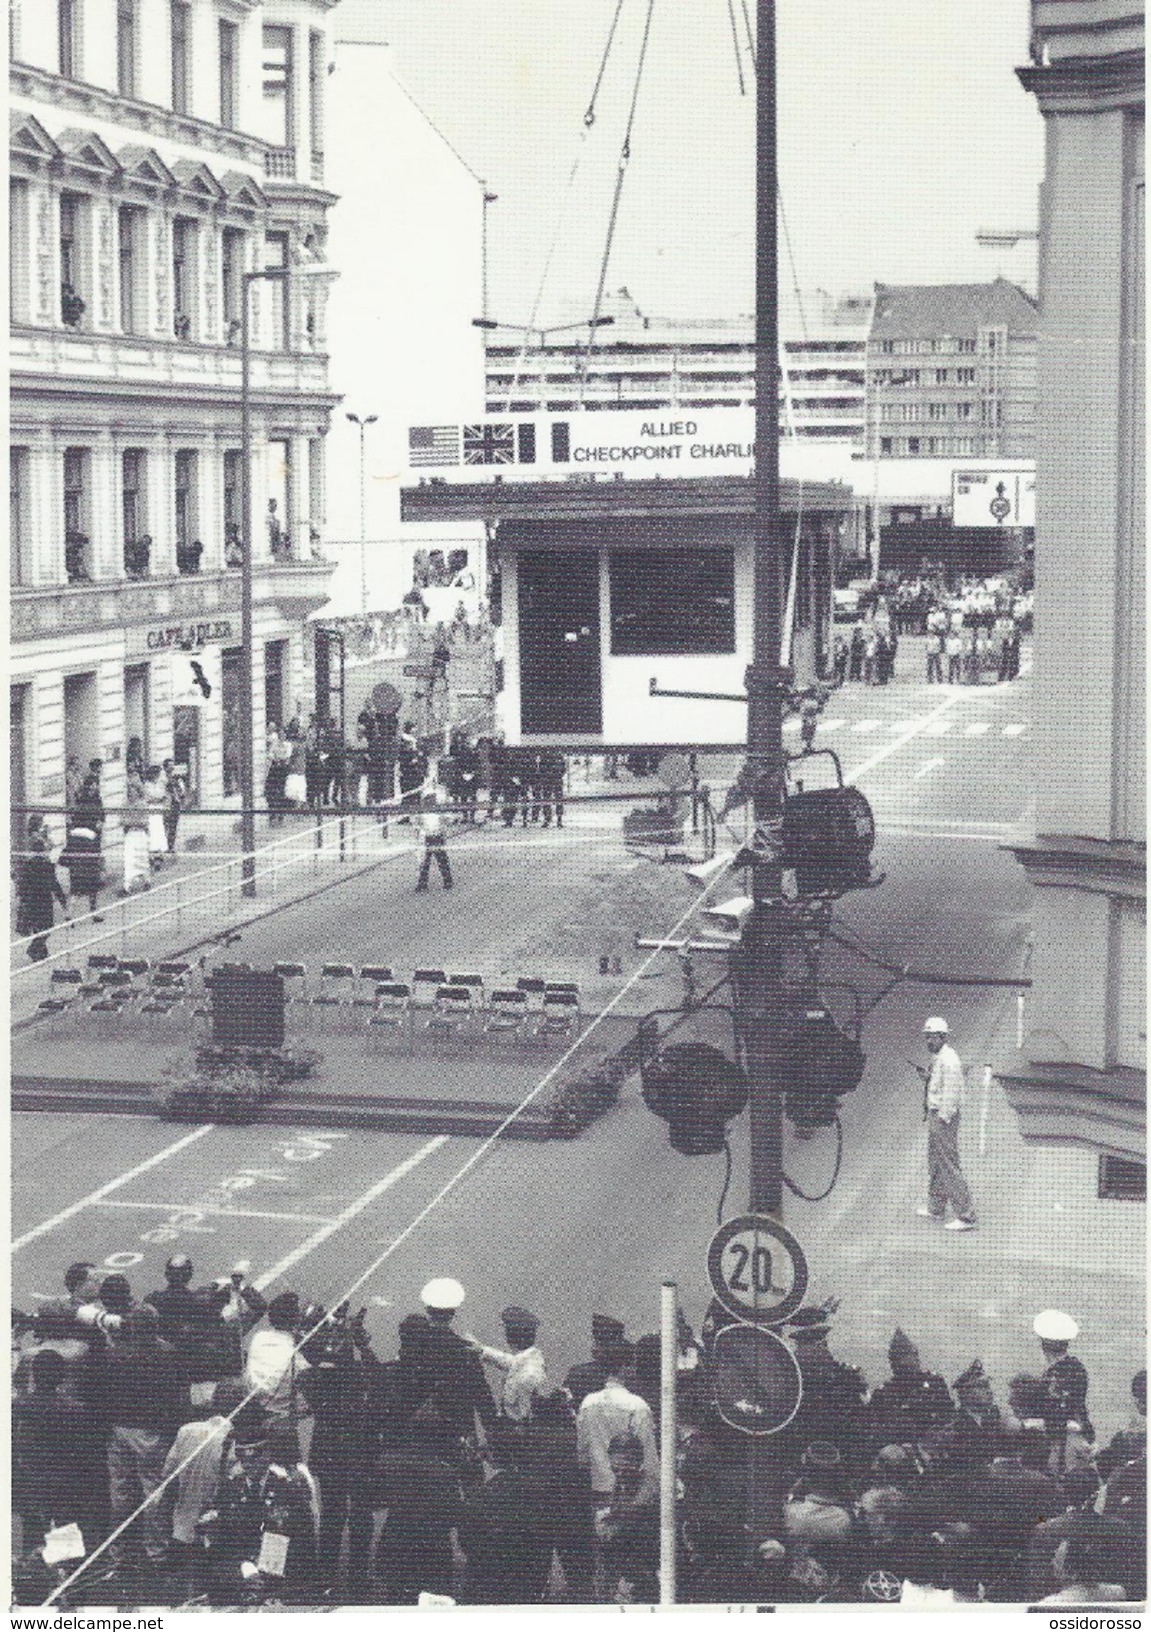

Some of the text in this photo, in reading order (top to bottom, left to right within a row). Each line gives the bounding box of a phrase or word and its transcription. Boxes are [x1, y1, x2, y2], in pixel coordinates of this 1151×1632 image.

[640, 421, 698, 437] ALLIED
[573, 443, 757, 463] CHECKPOINT CHARLI
[729, 1244, 772, 1293] 20
